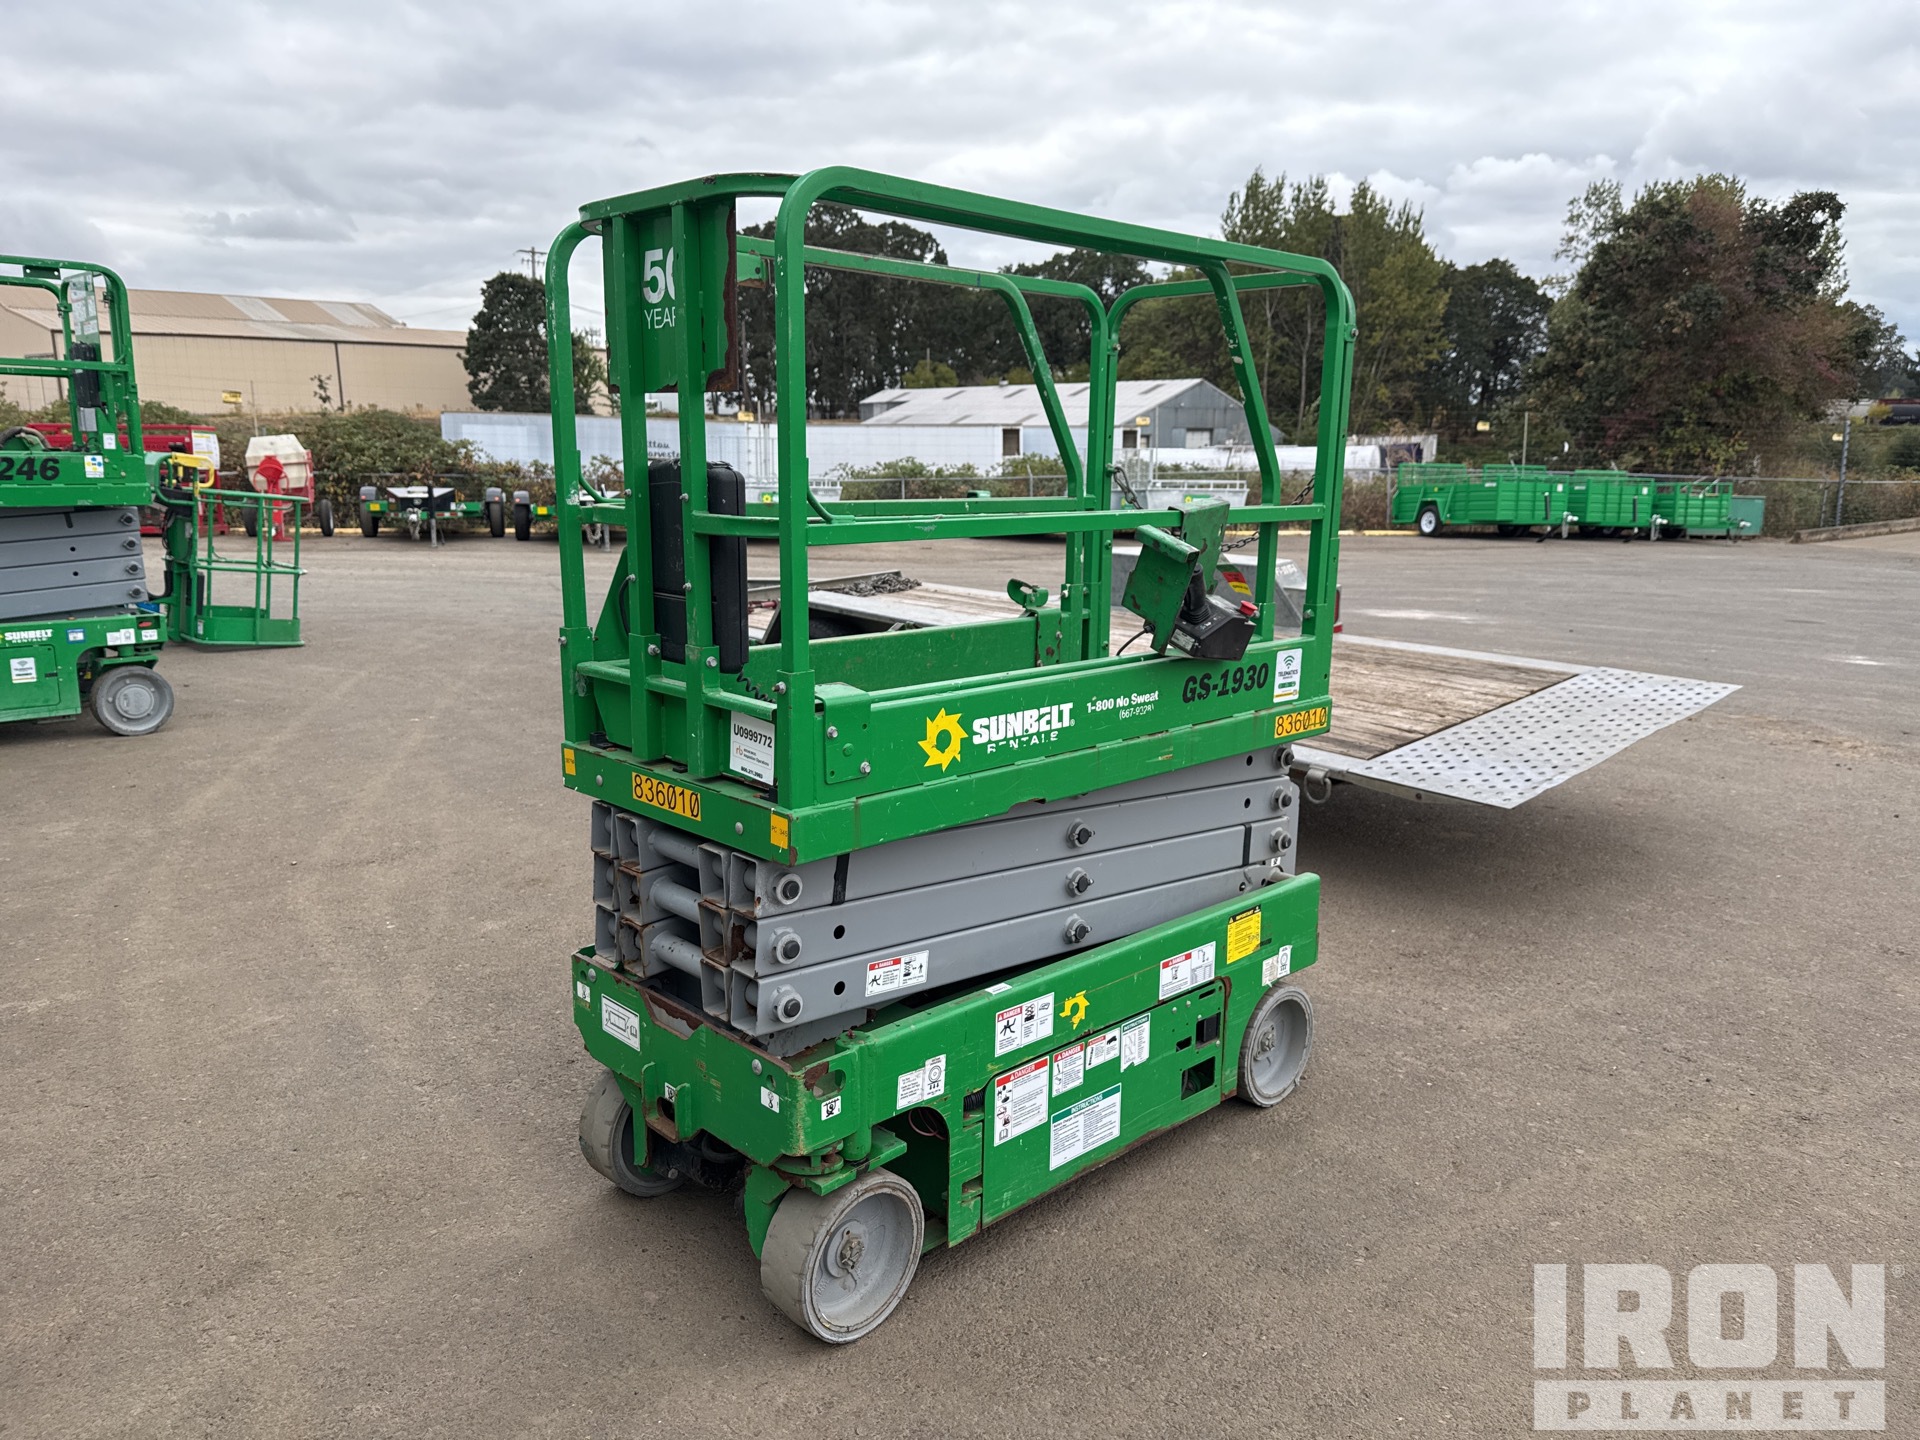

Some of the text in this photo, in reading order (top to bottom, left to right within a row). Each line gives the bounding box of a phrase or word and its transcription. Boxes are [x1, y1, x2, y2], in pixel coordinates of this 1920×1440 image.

[0, 456, 60, 481] 246
[4, 629, 53, 641] SUNBELT
[1182, 662, 1269, 704] GS-1930
[1086, 690, 1159, 714] 1-800 No Sweat
[972, 702, 1074, 745] SUNBELT
[1276, 707, 1327, 736] 836010
[733, 723, 773, 749] U0999772
[987, 730, 1059, 754] RNTALS
[633, 774, 700, 818] 836010
[1061, 1045, 1081, 1059] DANGER
[1014, 1064, 1036, 1079] DANGER
[1071, 1094, 1103, 1114] INSTRUCTIONS
